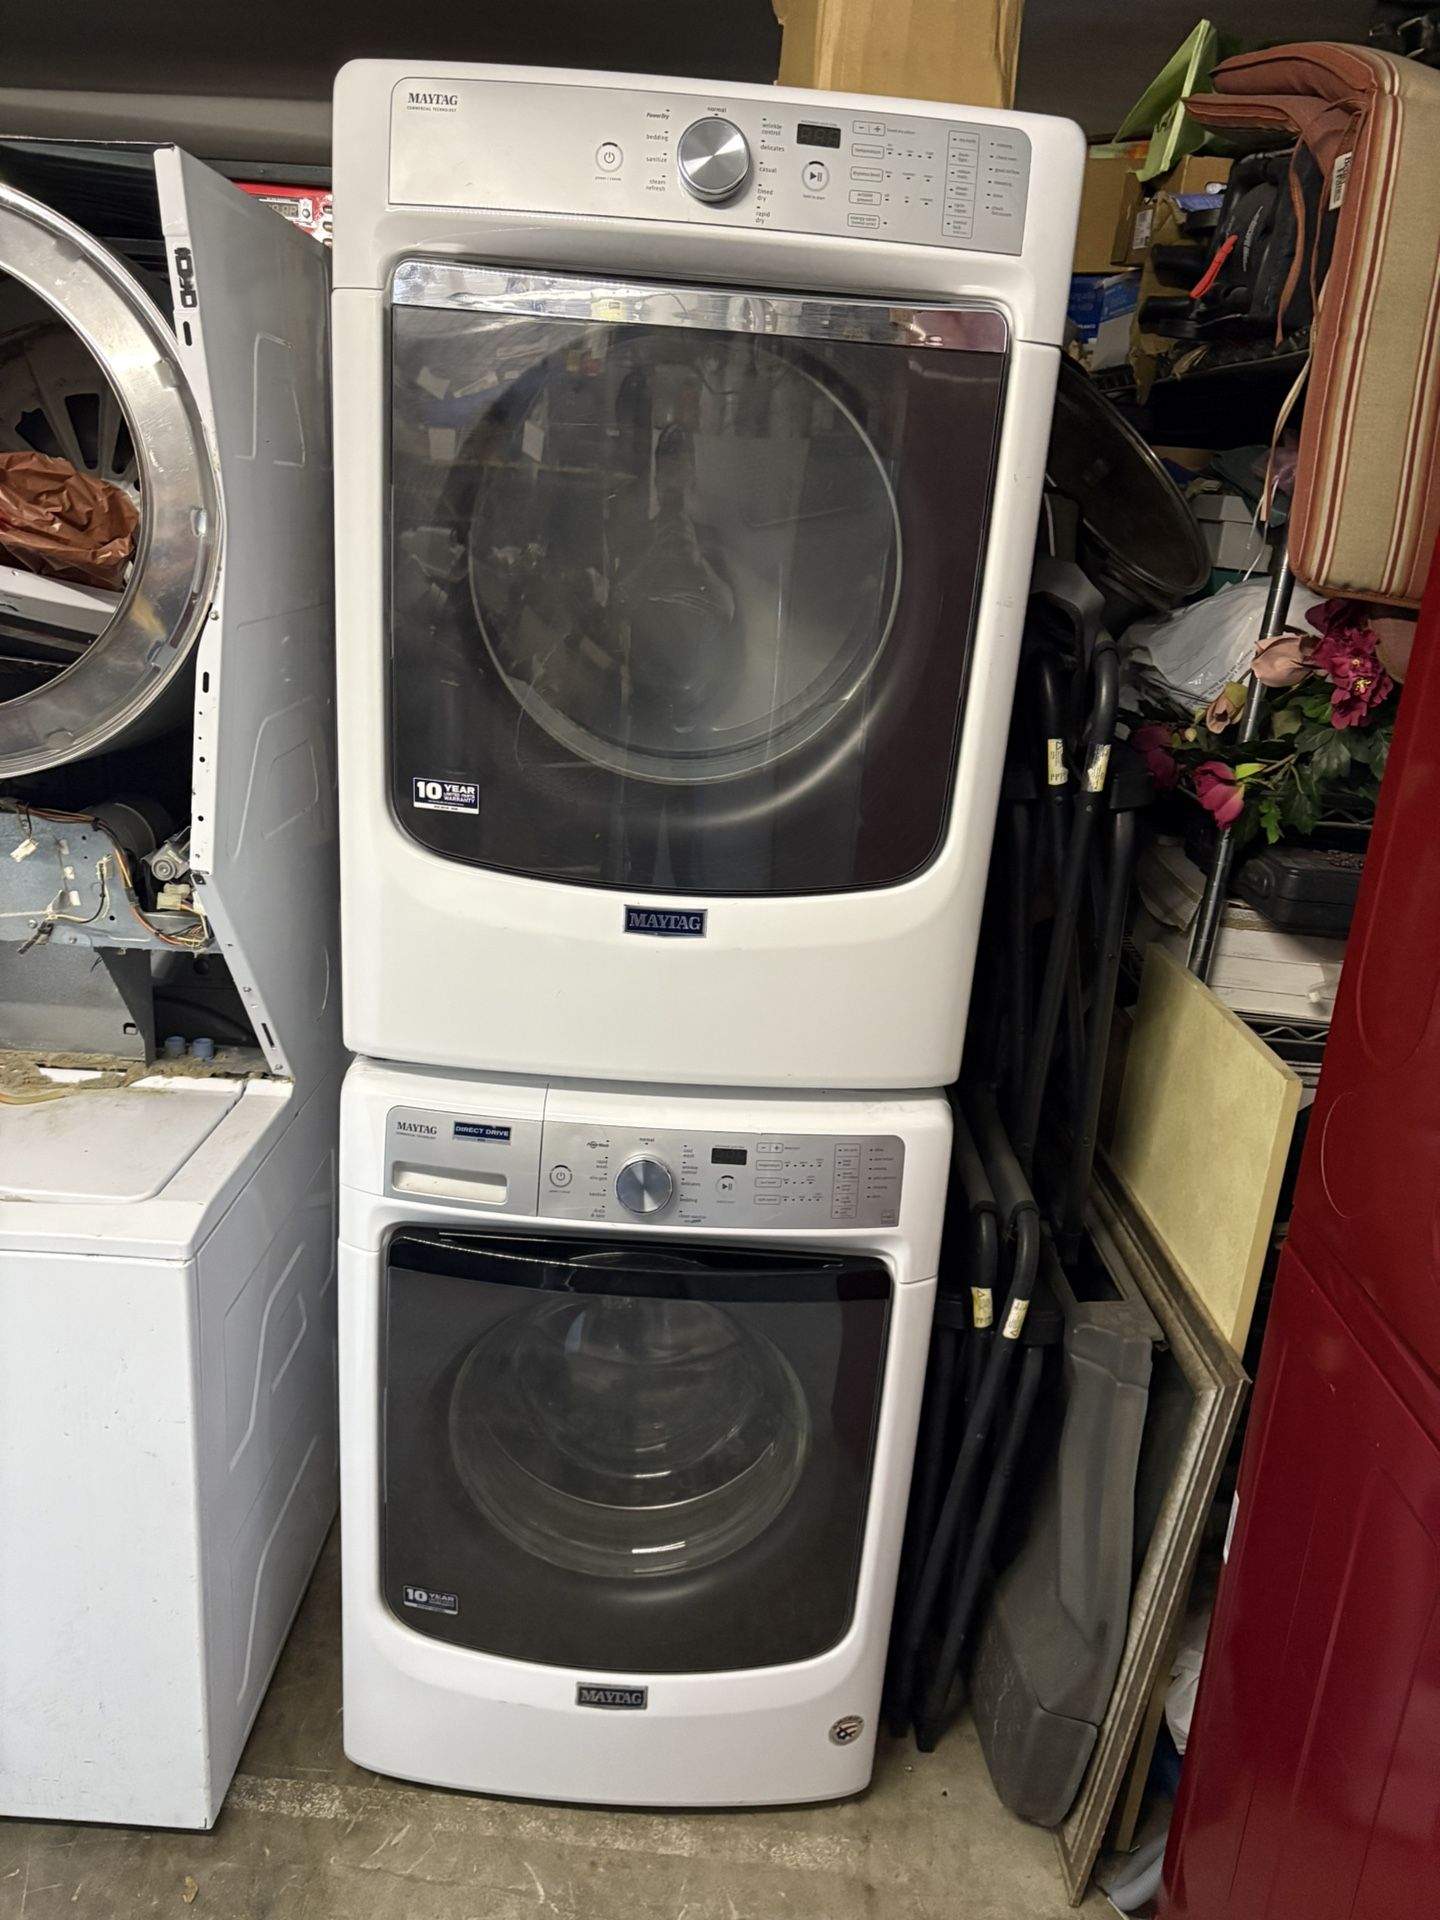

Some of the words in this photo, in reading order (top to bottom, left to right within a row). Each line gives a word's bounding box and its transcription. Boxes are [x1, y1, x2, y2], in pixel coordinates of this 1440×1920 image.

[407, 92, 458, 105] MAYTAG
[646, 134, 669, 142] bedding
[760, 144, 785, 152] delicates
[416, 781, 443, 800] 10
[443, 784, 476, 795] YEAR
[629, 912, 701, 930] MAYTAG
[396, 1121, 438, 1135] MAYTAG
[455, 1126, 483, 1134] DIRECT
[485, 1129, 509, 1137] DRIVE
[406, 1588, 428, 1602] 10
[429, 1593, 454, 1601] YEAR
[581, 1690, 642, 1704] MAYTAG
